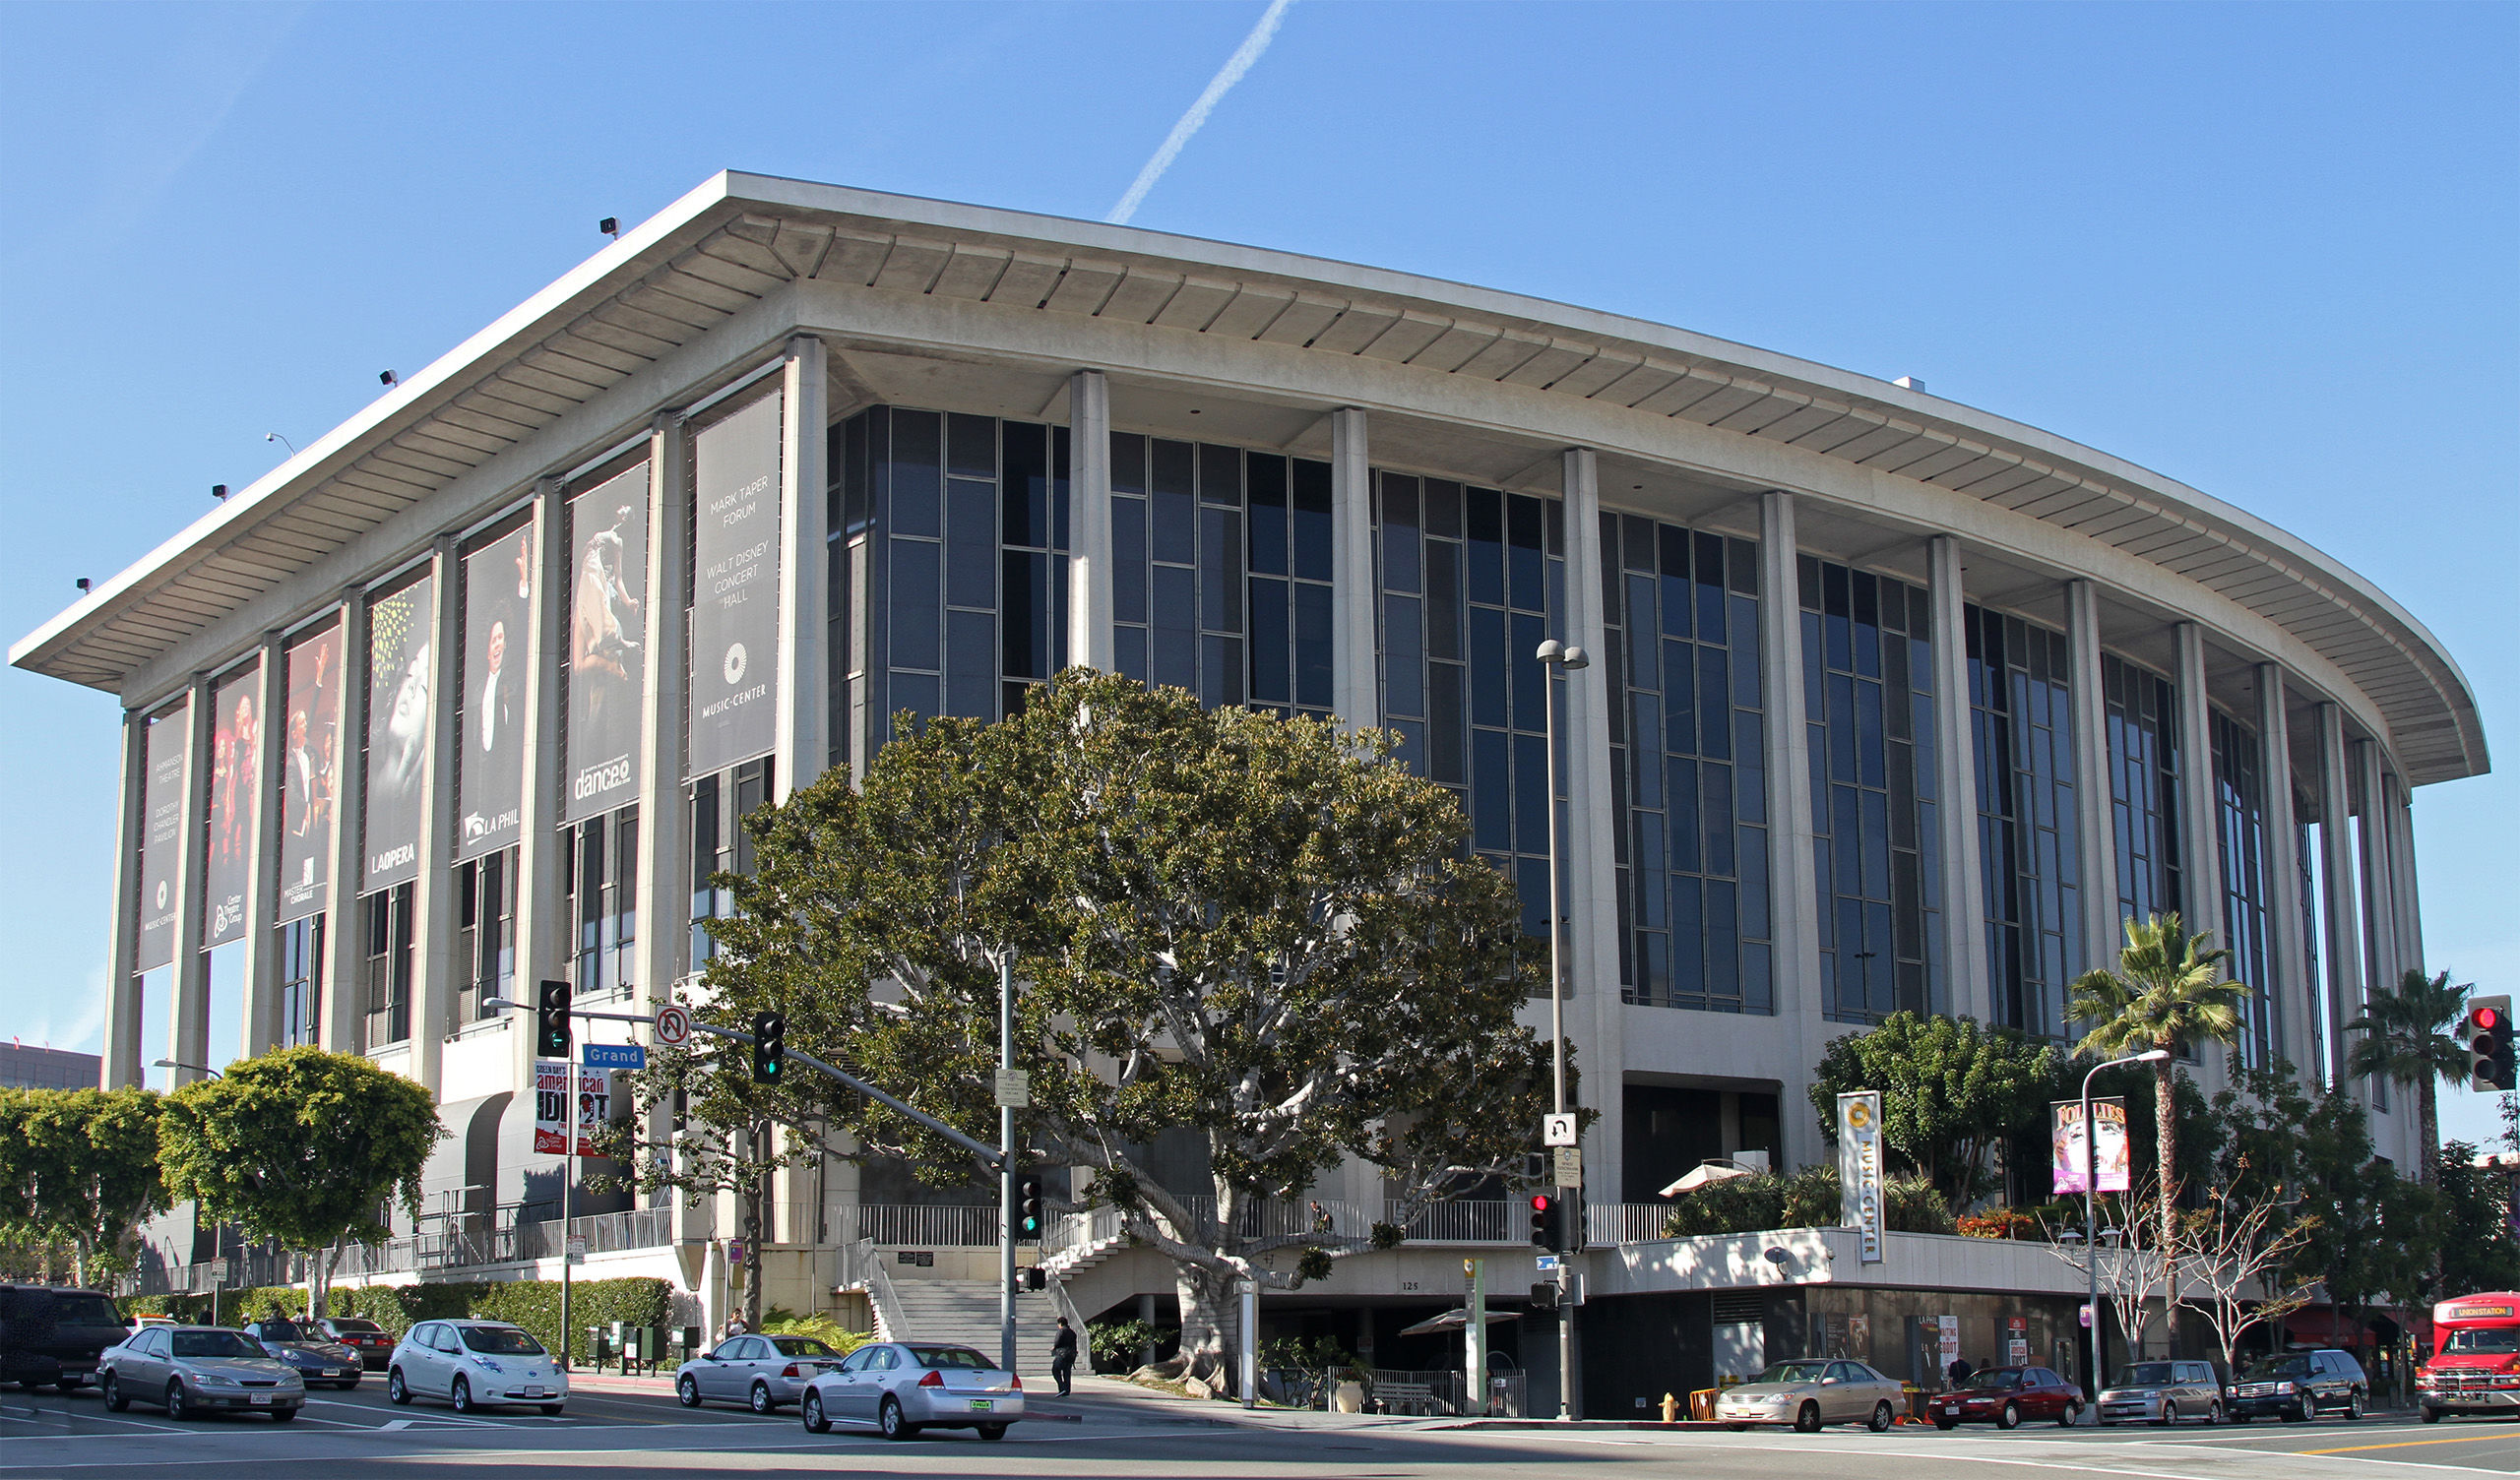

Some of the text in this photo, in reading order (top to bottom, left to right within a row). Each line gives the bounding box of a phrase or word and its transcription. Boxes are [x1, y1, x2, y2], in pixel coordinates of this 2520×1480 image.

[710, 475, 769, 515] MARK TAPER
[723, 501, 756, 528] FORUM
[706, 539, 769, 580] WALT DISNEY
[715, 564, 758, 594] CONCERT
[724, 587, 748, 610] HALL
[484, 808, 519, 834] LA PHIL
[591, 1048, 638, 1063] Grand
[1402, 1281, 1418, 1291] 125
[2478, 1307, 2506, 1316] STATION
